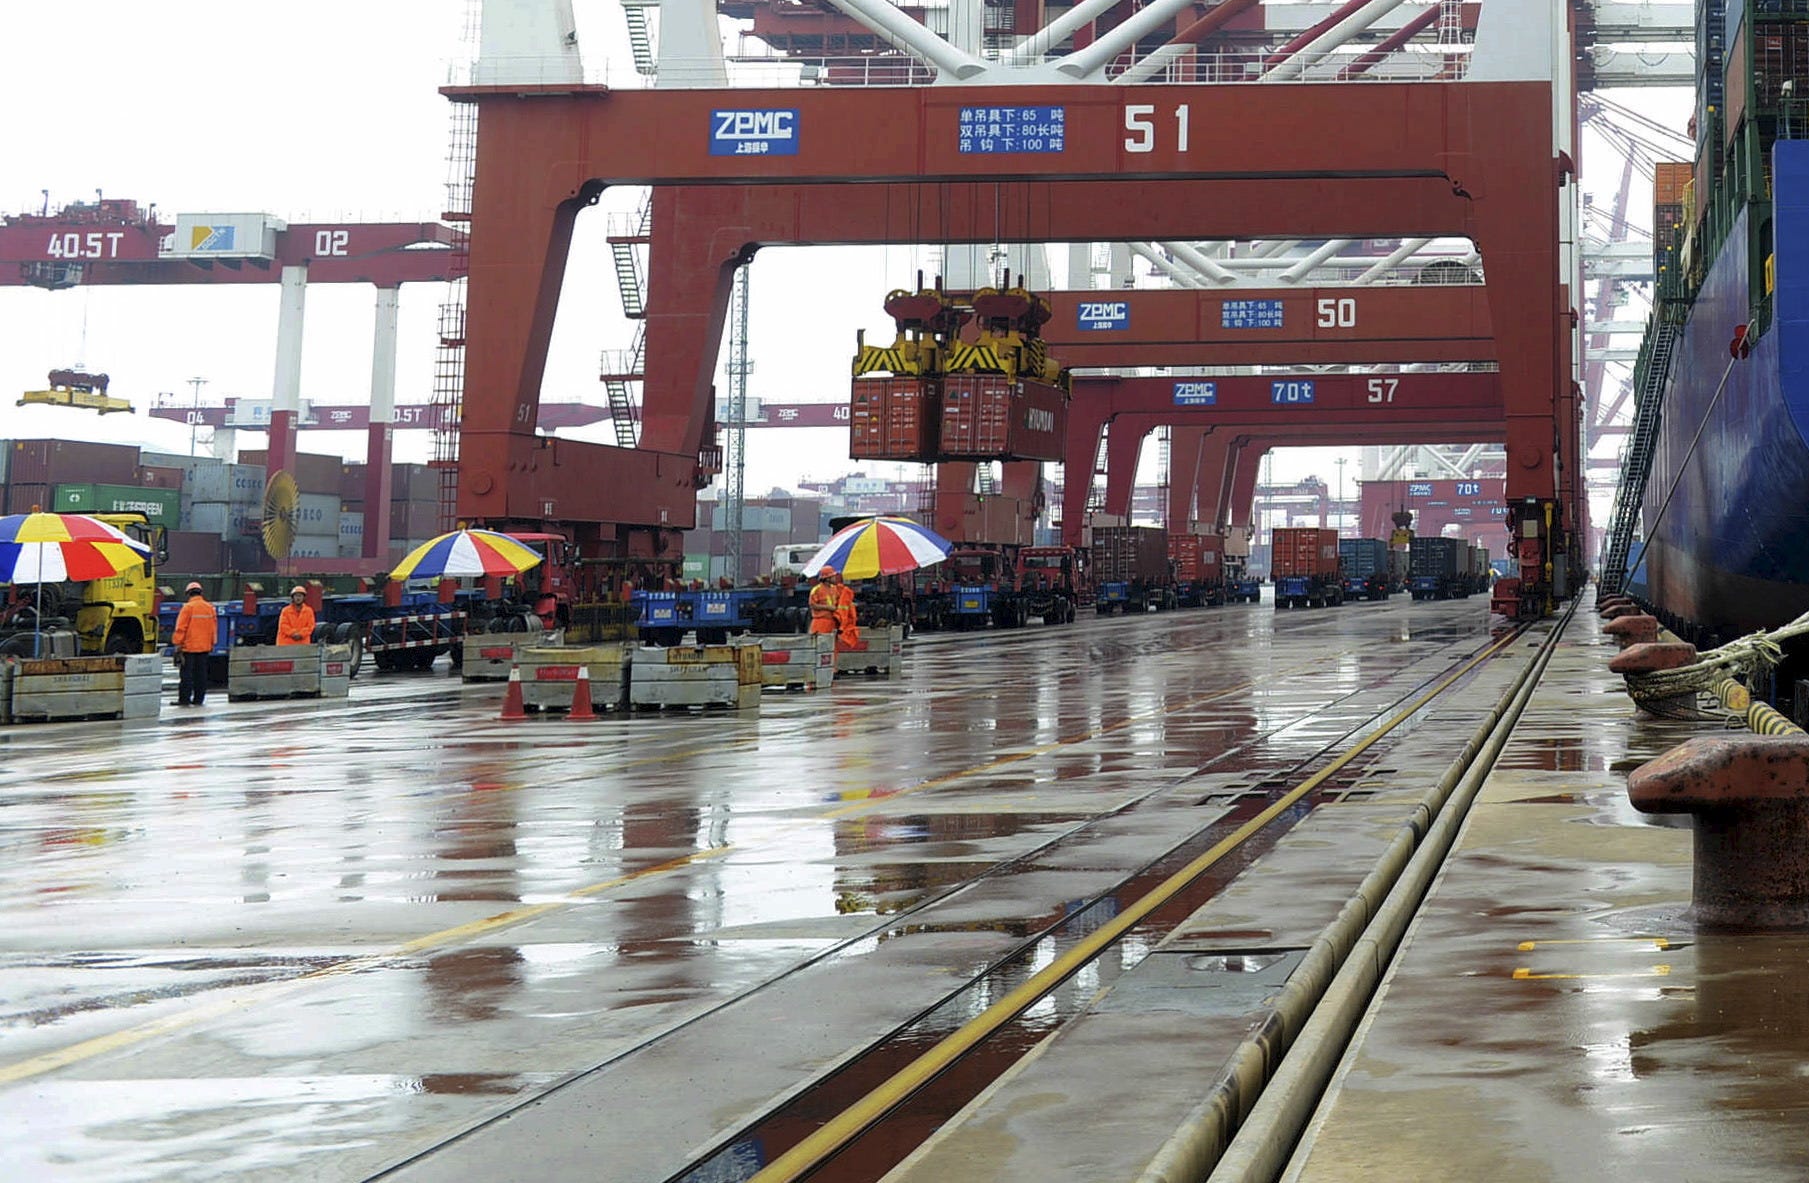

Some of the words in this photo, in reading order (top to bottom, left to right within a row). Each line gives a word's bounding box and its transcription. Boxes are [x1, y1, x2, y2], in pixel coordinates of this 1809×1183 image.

[715, 112, 793, 139] ZPMC
[1124, 104, 1189, 153] 51
[315, 230, 349, 256] 02
[1080, 303, 1125, 320] ZPMC
[1318, 298, 1356, 328] 50
[1176, 383, 1213, 397] ZPMC
[1273, 382, 1312, 401] 70t
[1368, 378, 1399, 403] 57
[186, 410, 205, 425] 04
